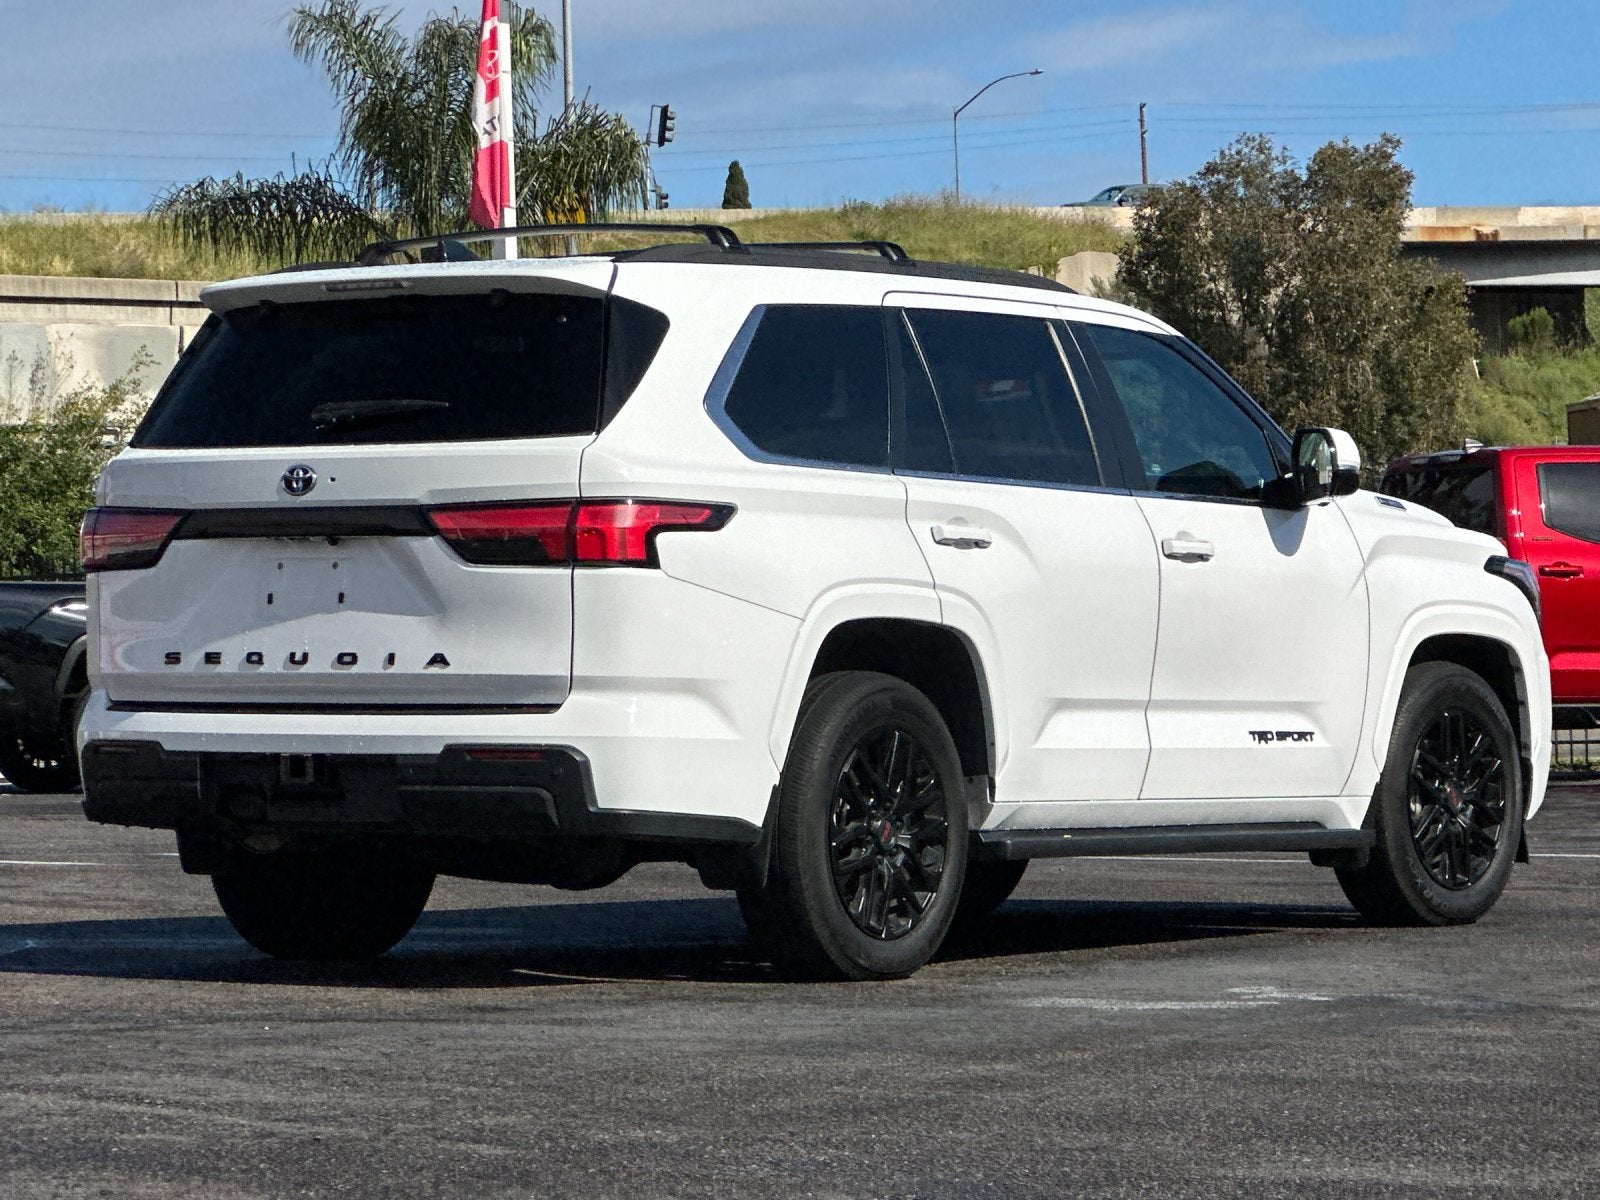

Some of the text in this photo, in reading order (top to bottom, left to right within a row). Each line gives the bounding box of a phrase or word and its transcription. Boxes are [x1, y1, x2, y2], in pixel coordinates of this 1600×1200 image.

[164, 651, 451, 666] SEQUOIA
[1248, 730, 1315, 745] TRD SPORT
